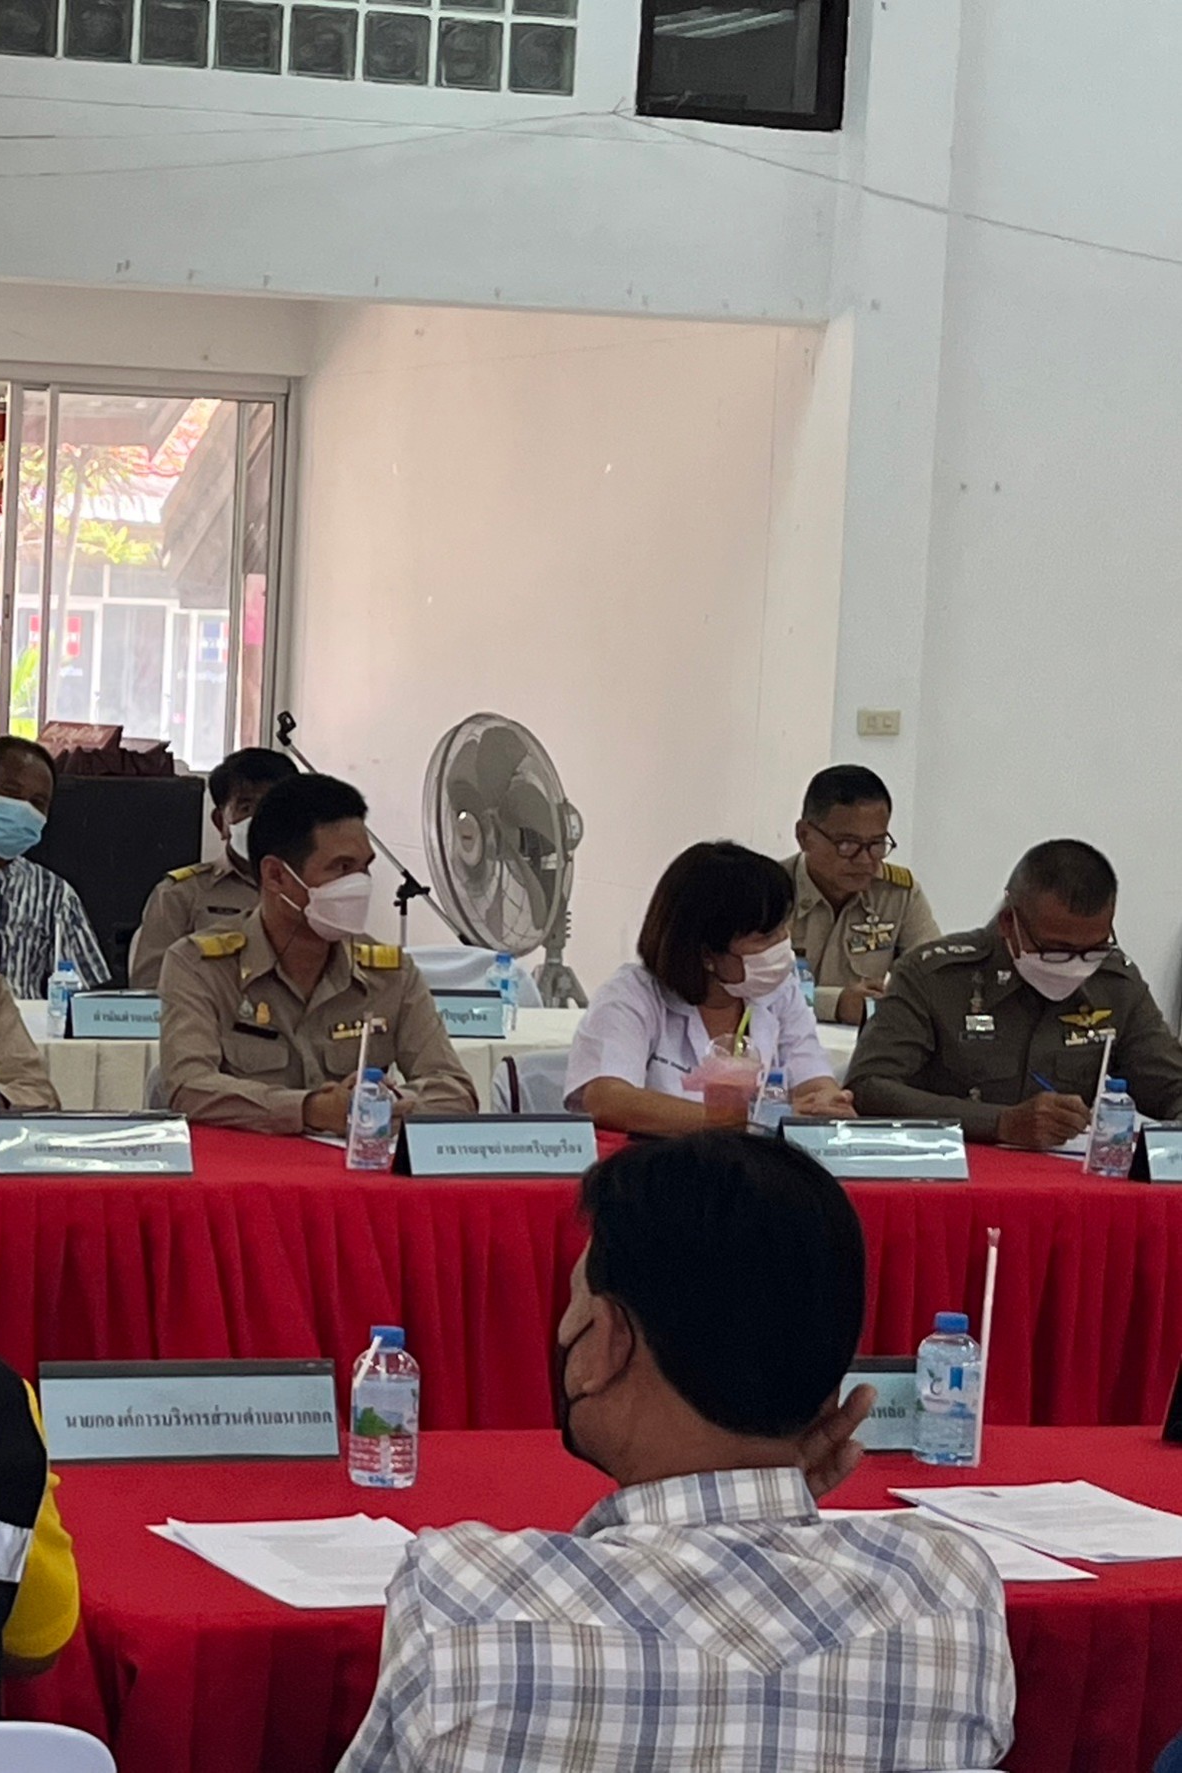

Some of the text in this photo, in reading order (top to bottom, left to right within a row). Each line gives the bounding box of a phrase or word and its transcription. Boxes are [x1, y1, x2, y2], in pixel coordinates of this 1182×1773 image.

[65, 1405, 334, 1429] นายกองค์การบริหารส่วนตำบลนากอก
